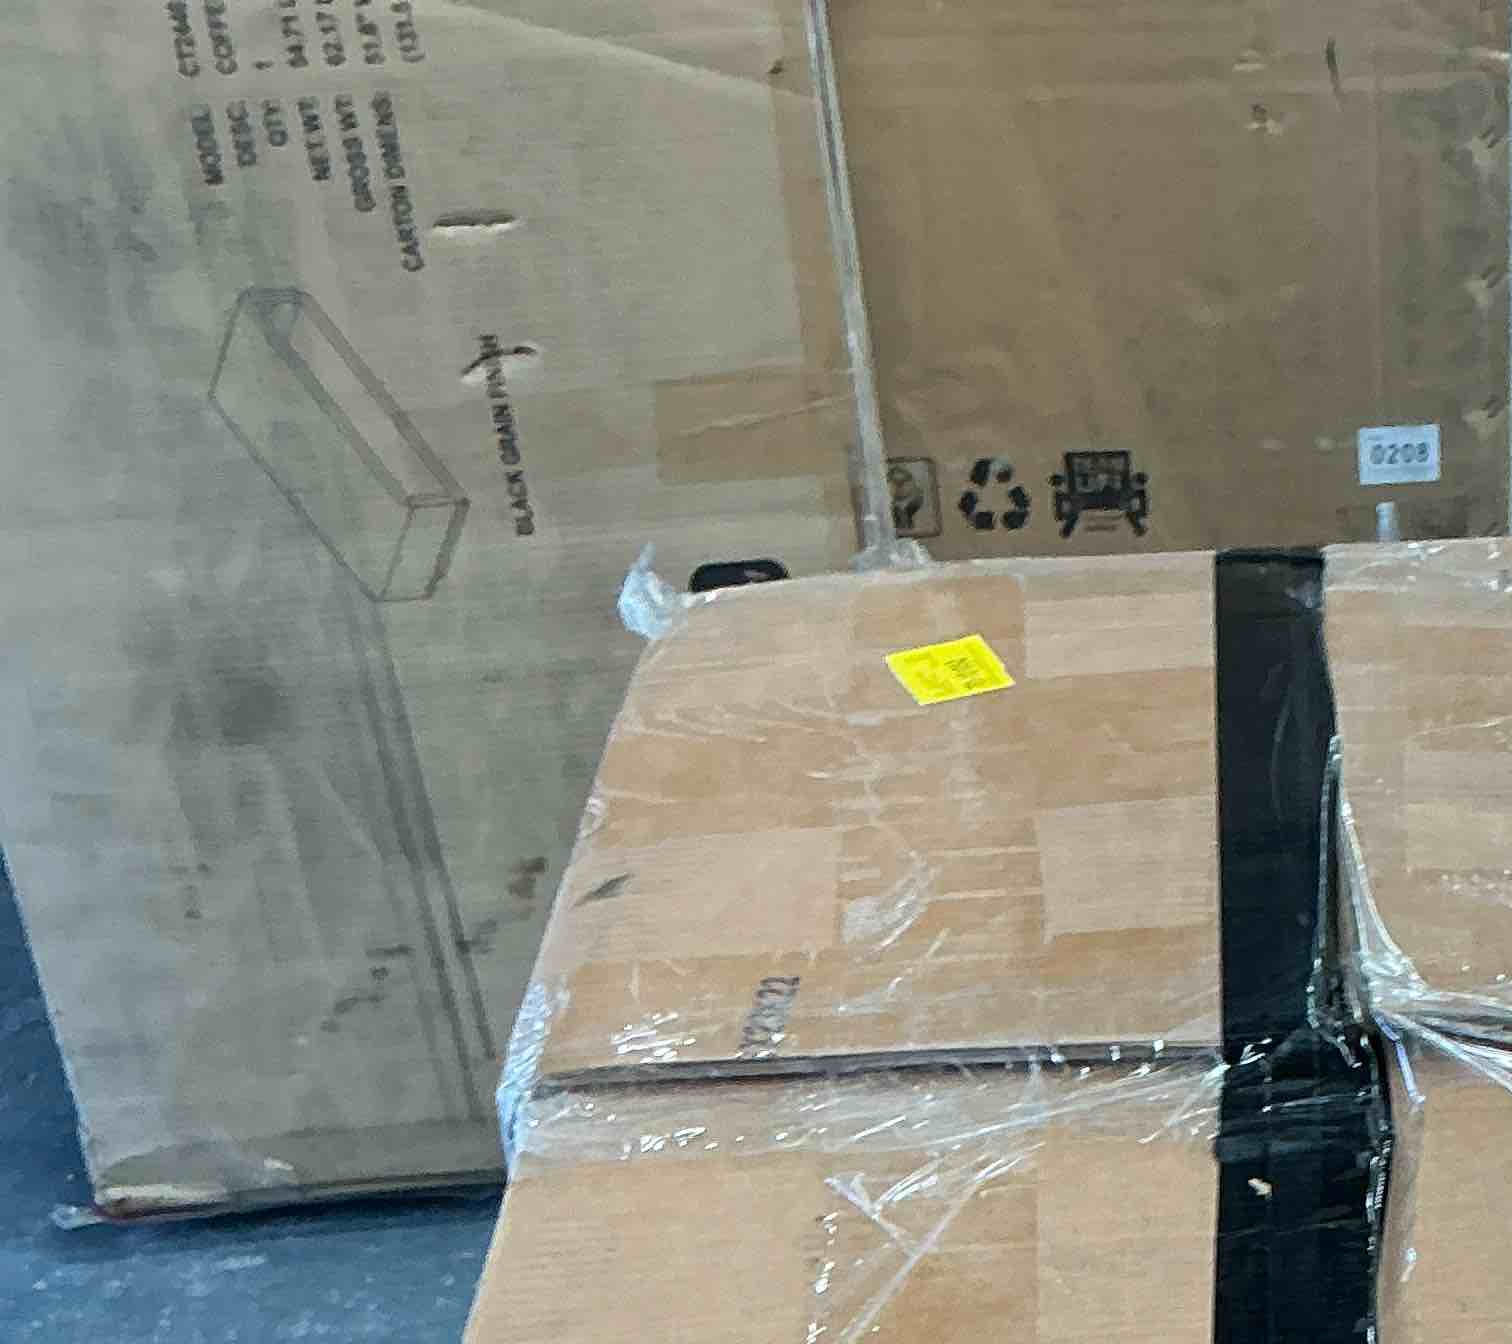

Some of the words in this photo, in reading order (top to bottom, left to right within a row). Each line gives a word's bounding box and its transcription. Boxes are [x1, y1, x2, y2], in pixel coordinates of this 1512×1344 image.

[263, 100, 288, 147] QTY
[389, 184, 425, 272] CARTON
[505, 473, 536, 536] BLACK
